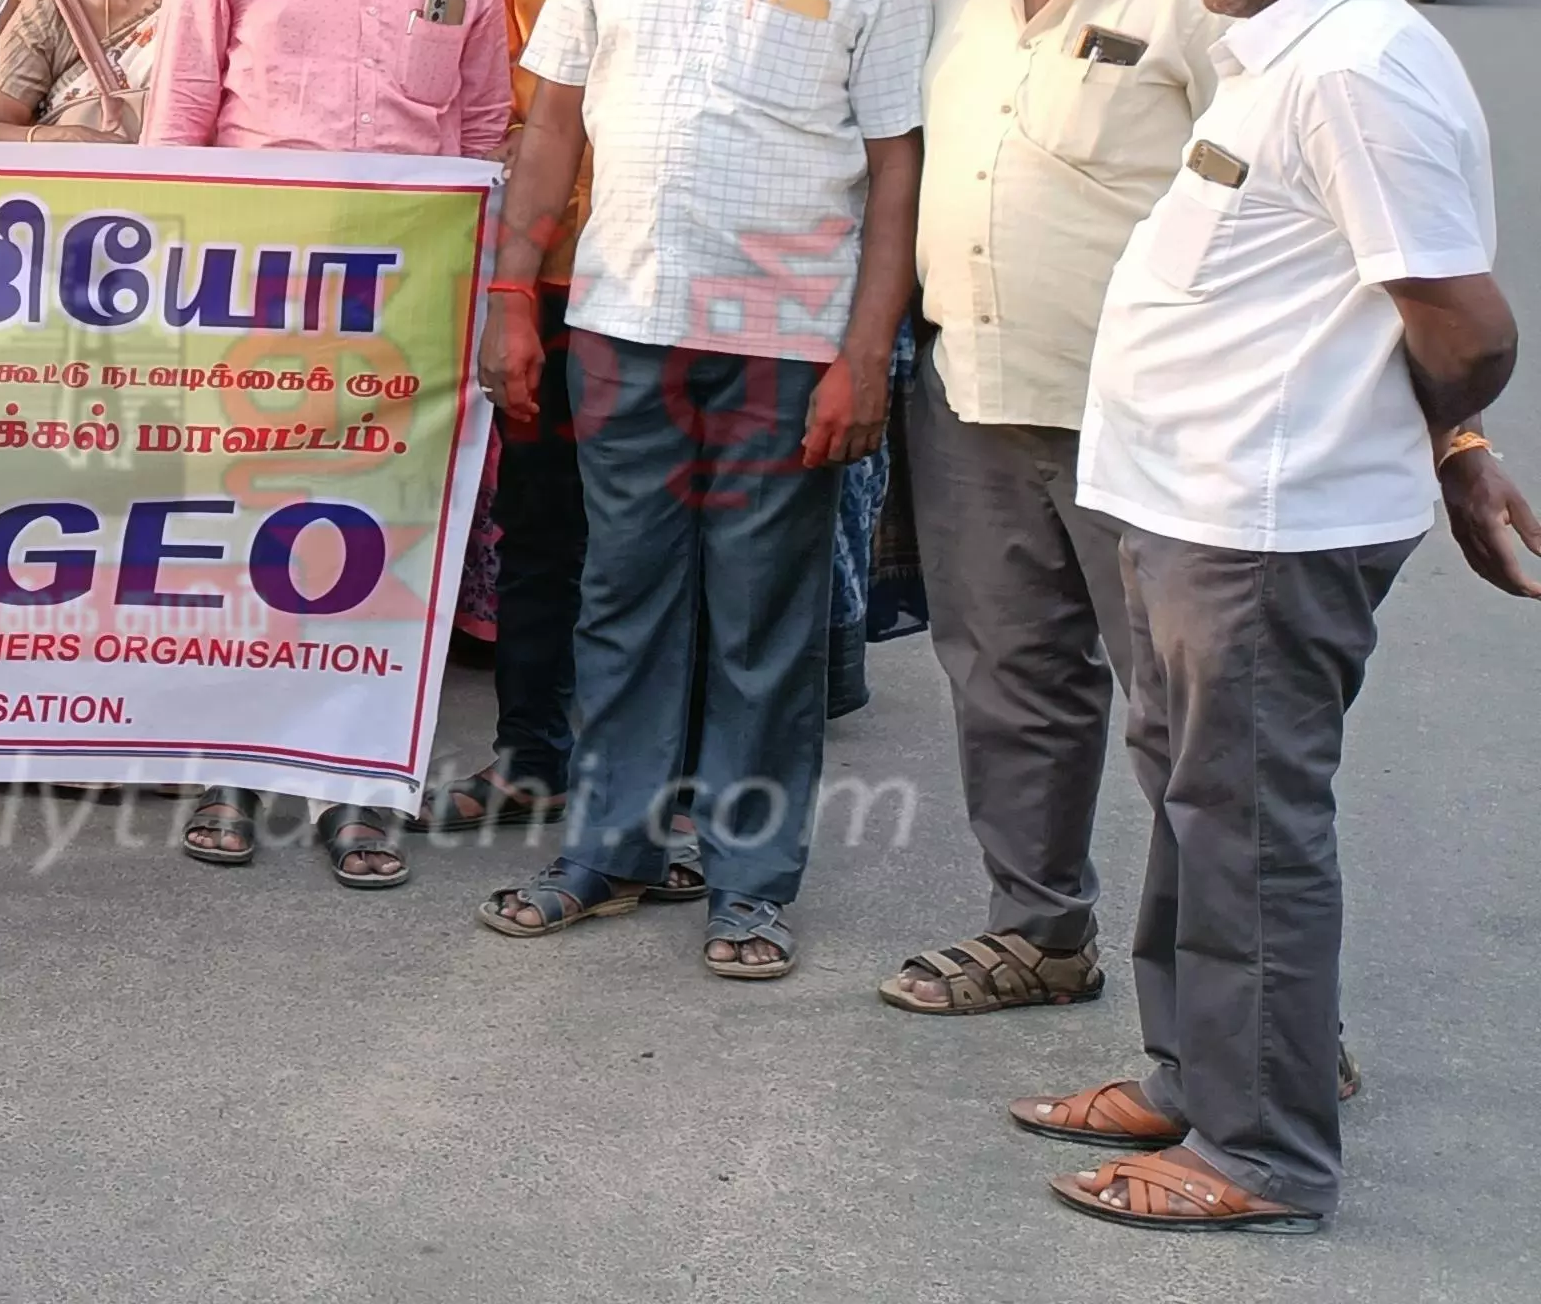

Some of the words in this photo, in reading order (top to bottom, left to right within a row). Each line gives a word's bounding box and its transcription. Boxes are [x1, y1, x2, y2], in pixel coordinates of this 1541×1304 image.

[346, 368, 421, 401] குழு
[136, 410, 408, 457] மாவட்டம்.
[94, 634, 403, 677] ORGANISATION-
